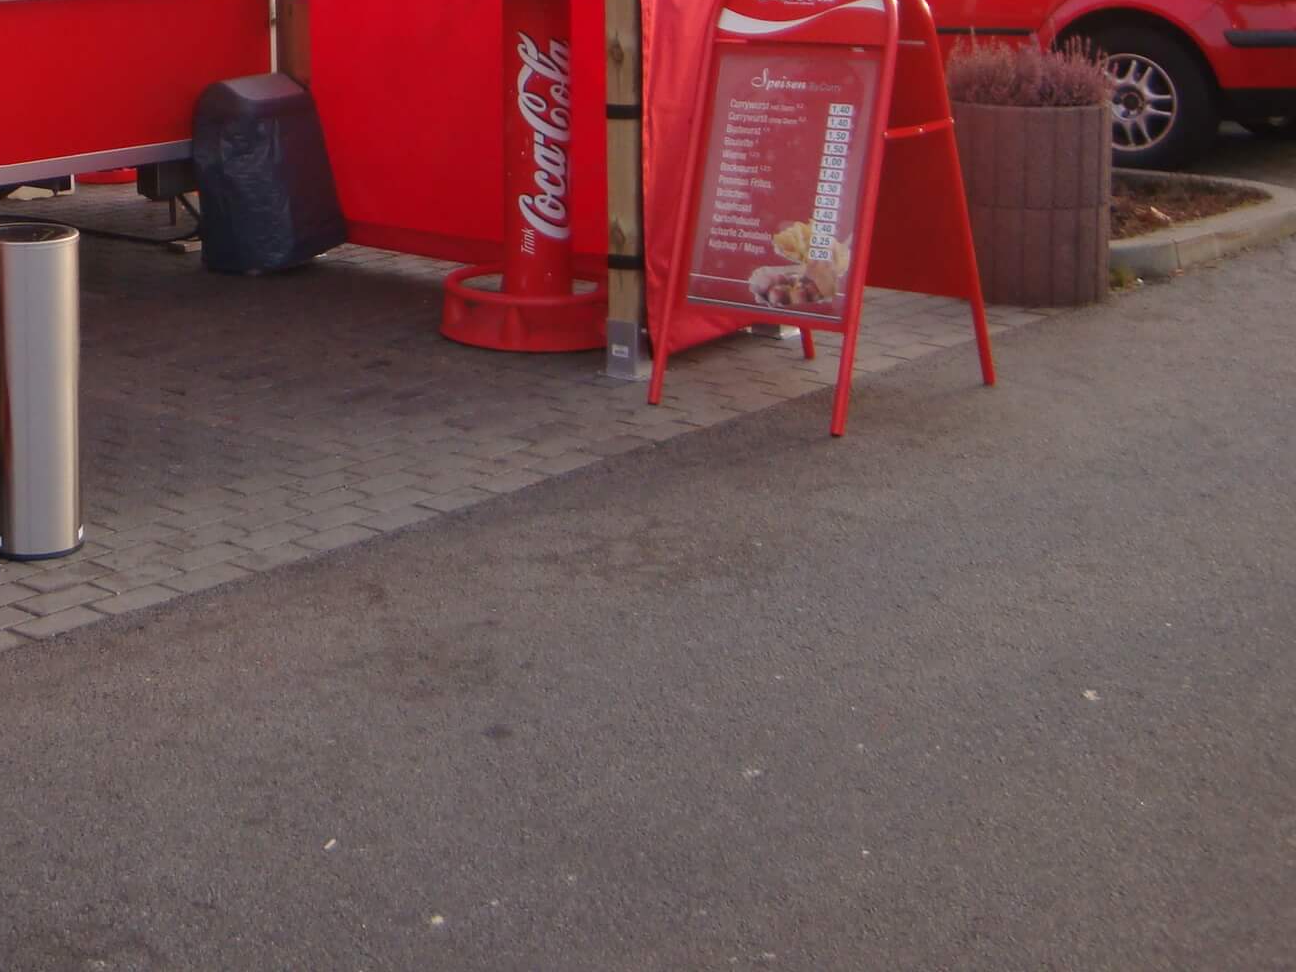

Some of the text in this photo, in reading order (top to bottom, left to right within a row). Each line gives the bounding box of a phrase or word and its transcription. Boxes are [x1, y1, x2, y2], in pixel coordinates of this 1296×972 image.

[750, 68, 807, 91] Speisen
[831, 105, 851, 114] 1,40
[520, 227, 536, 256] Trink
